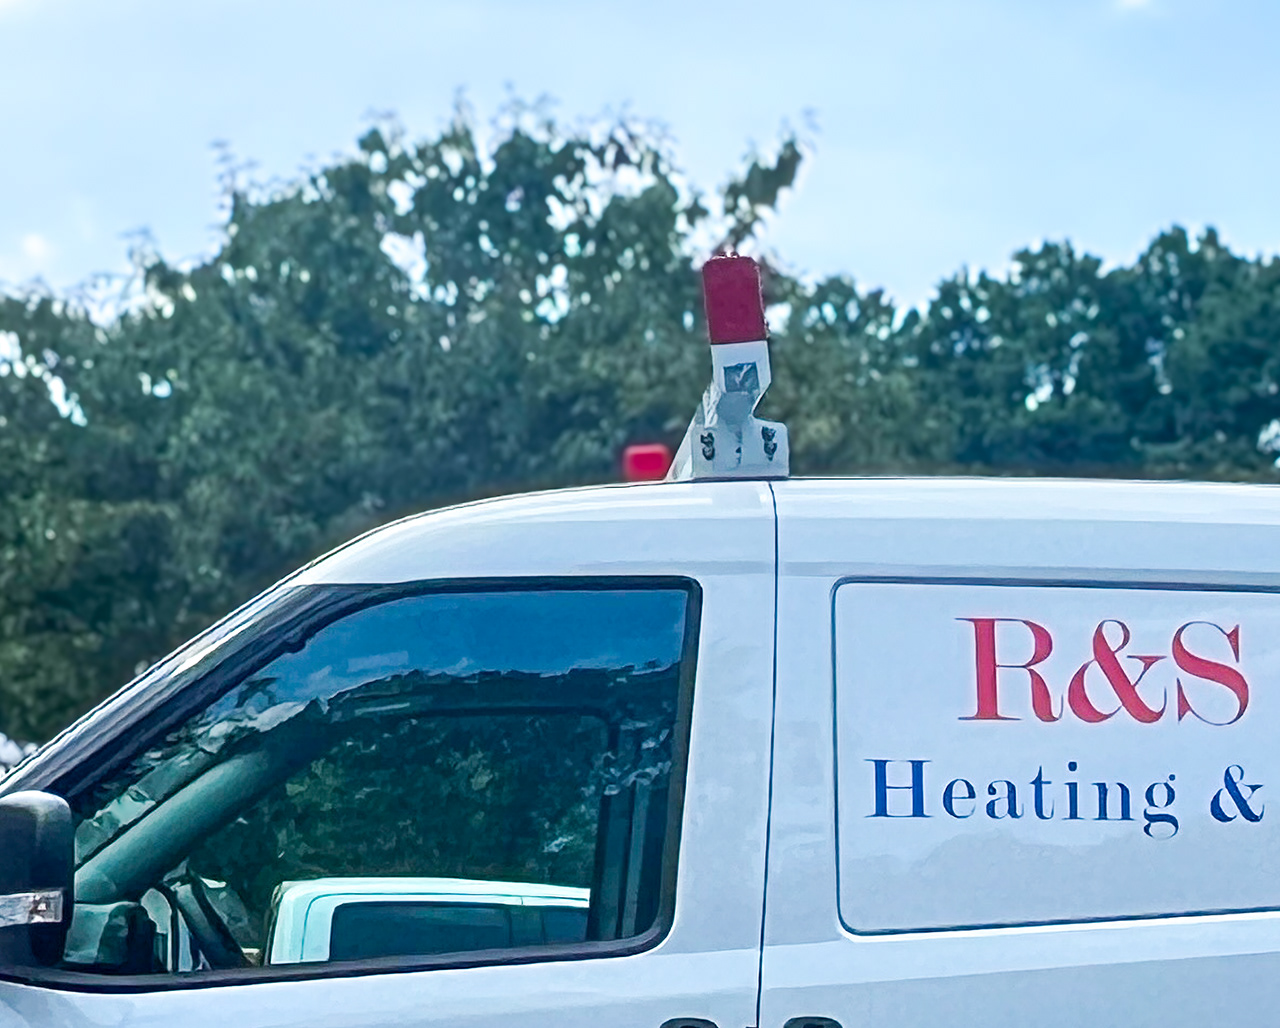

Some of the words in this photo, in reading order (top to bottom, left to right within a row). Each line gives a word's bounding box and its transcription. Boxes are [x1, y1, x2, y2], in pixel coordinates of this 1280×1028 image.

[954, 616, 1250, 726] R&S
[864, 759, 1180, 840] Heating
[1209, 765, 1265, 824] &
